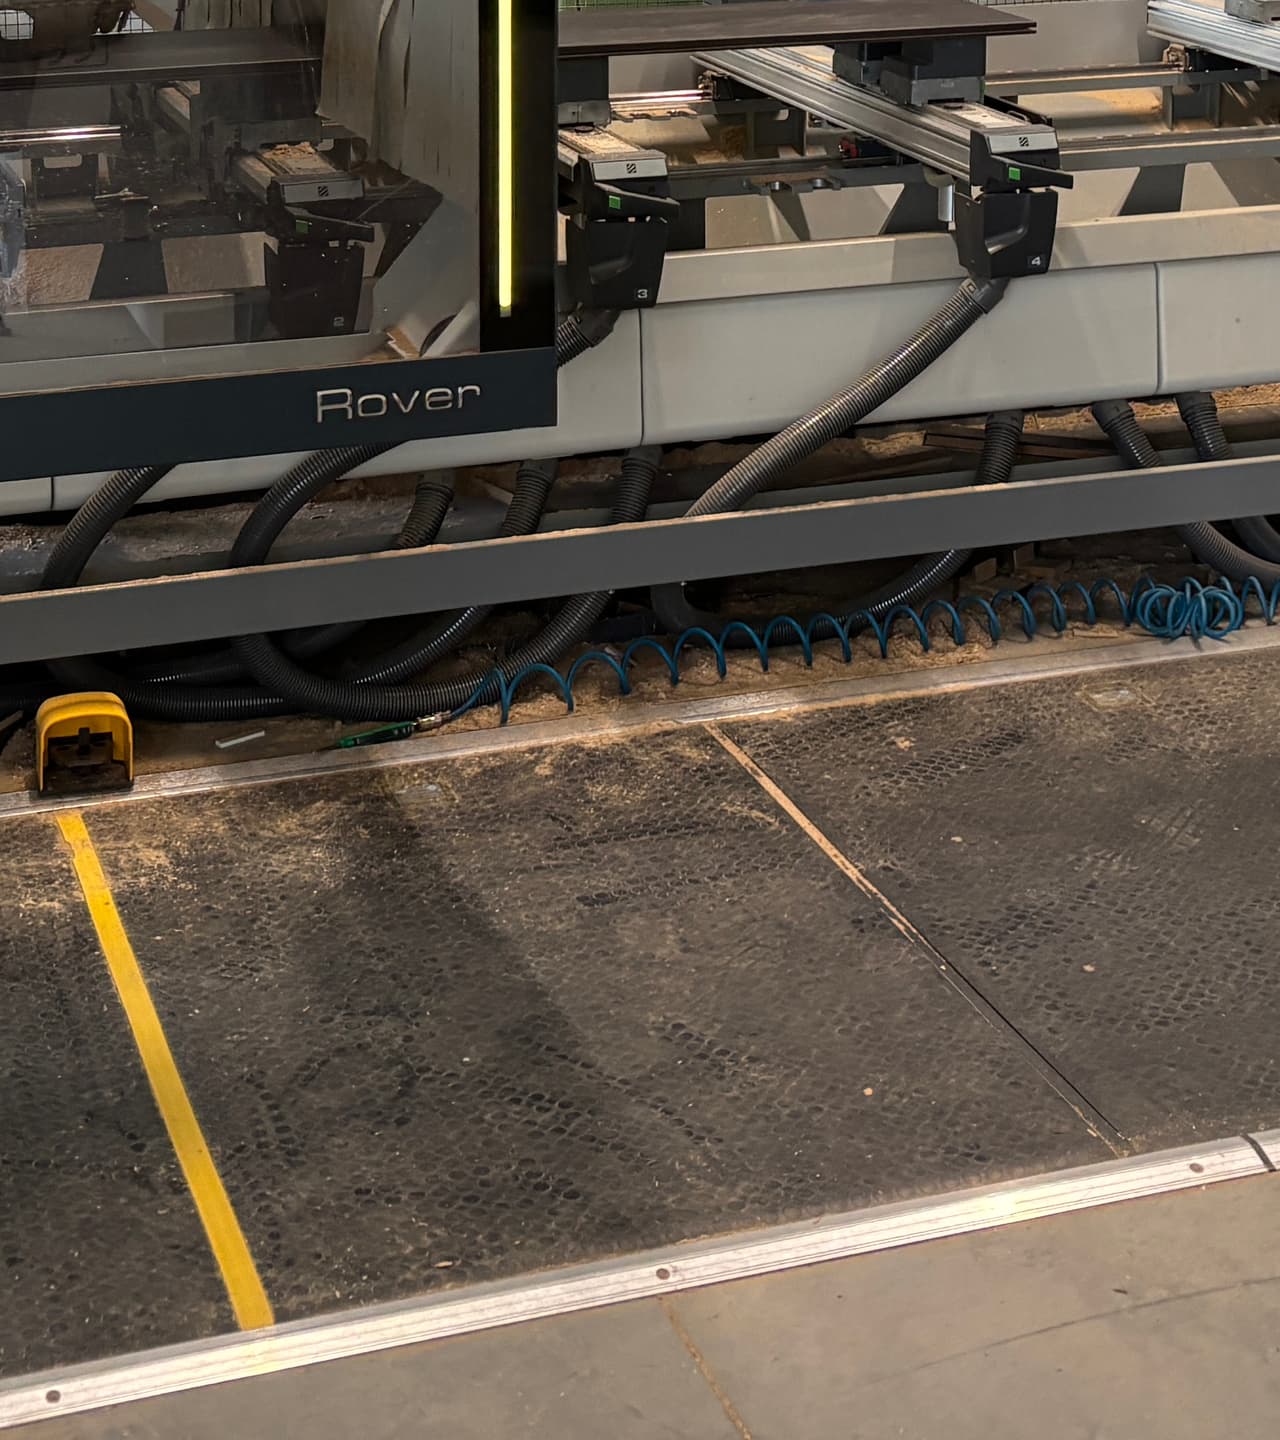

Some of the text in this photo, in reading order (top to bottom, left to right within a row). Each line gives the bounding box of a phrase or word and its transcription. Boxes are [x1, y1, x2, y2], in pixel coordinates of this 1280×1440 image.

[1031, 256, 1040, 265] 4
[638, 289, 647, 298] 3
[317, 384, 481, 423] Rover
